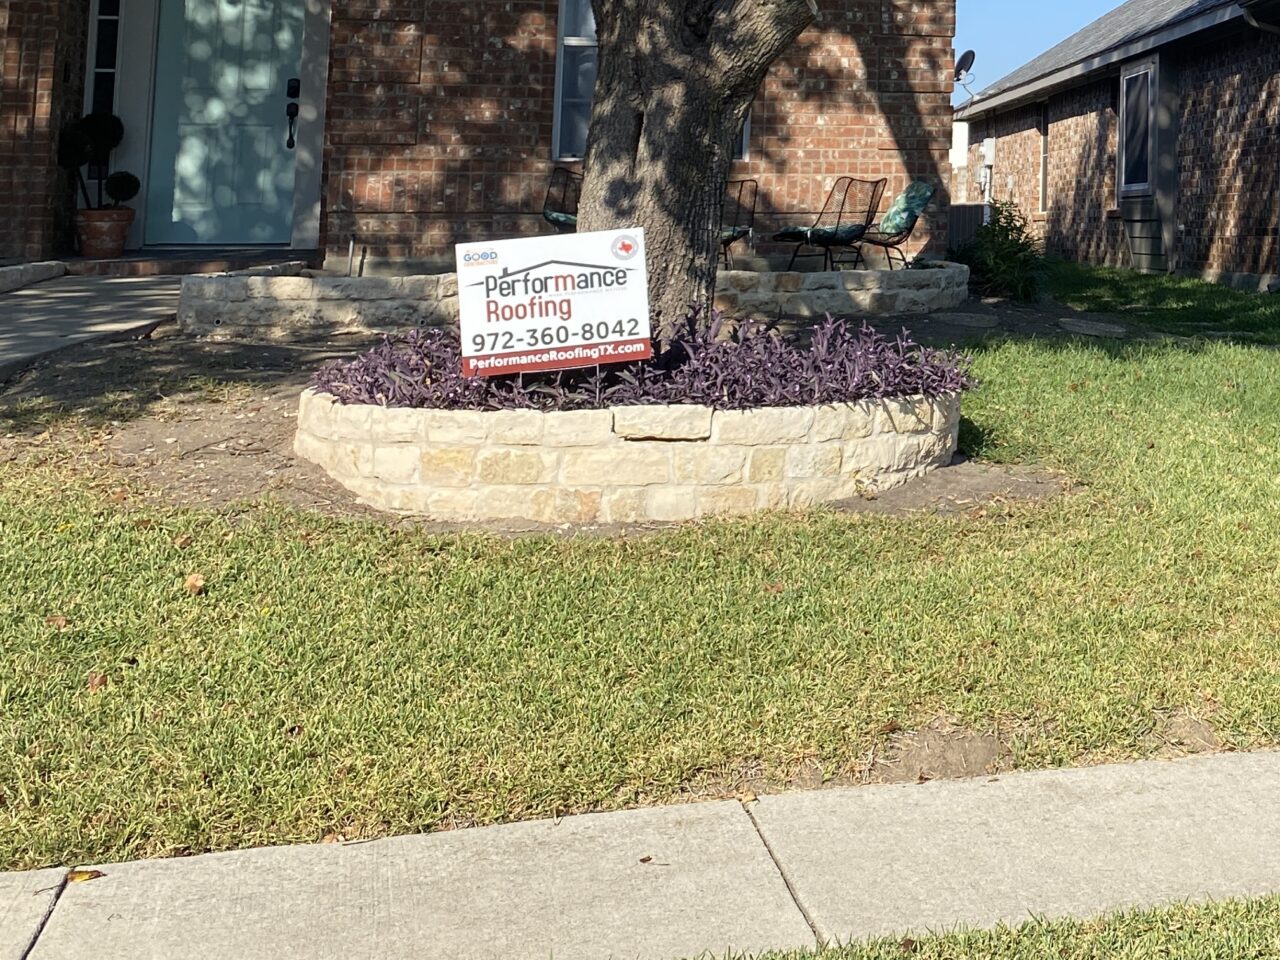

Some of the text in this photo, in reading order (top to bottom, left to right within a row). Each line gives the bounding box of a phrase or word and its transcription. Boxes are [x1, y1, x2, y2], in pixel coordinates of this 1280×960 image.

[463, 251, 498, 262] GOOD
[485, 268, 627, 298] Performance
[486, 296, 572, 323] Roofing
[472, 318, 640, 353] 972-360-8042
[469, 342, 645, 370] PerformanceRoofingTX.com
